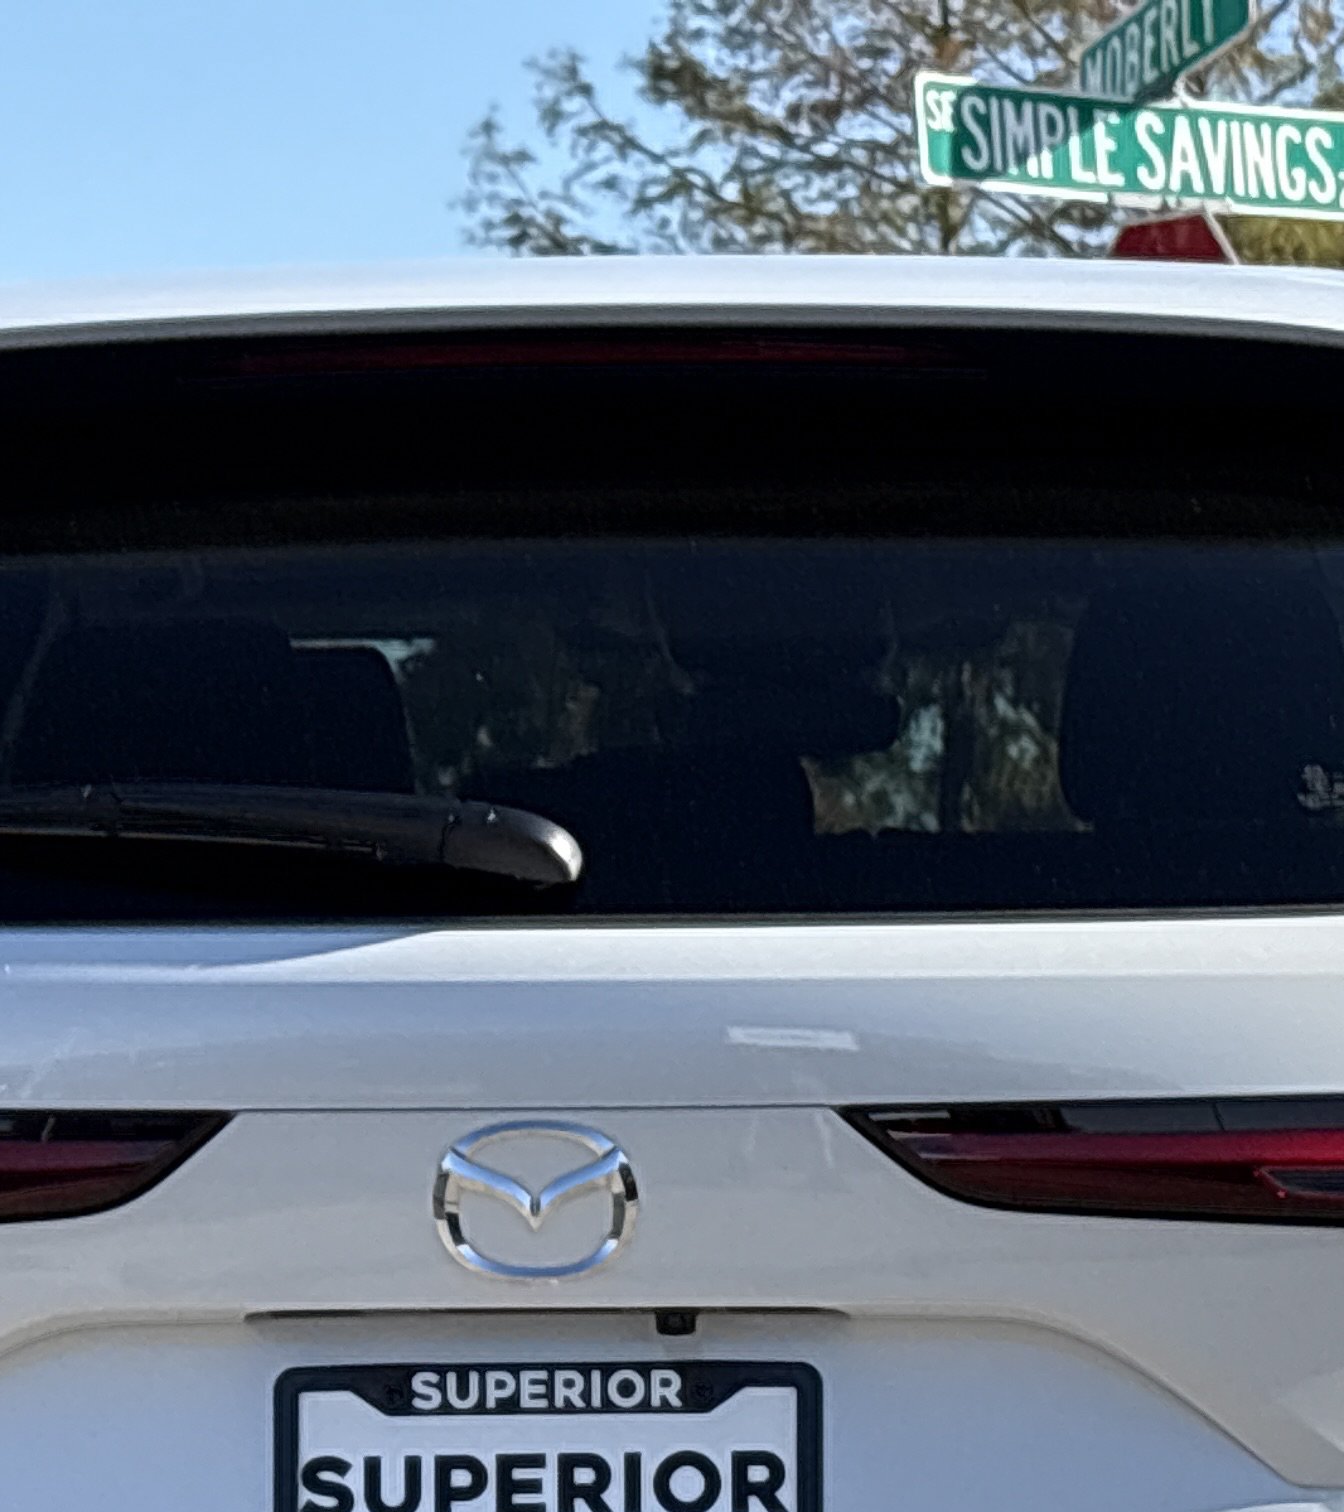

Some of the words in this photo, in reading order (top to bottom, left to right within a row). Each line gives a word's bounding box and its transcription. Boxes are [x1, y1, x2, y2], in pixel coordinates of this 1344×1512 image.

[926, 89, 955, 132] SE
[960, 95, 1125, 187] SIMPLE
[1134, 110, 1336, 204] SAVINGS
[411, 1369, 683, 1411] SUPERIOR
